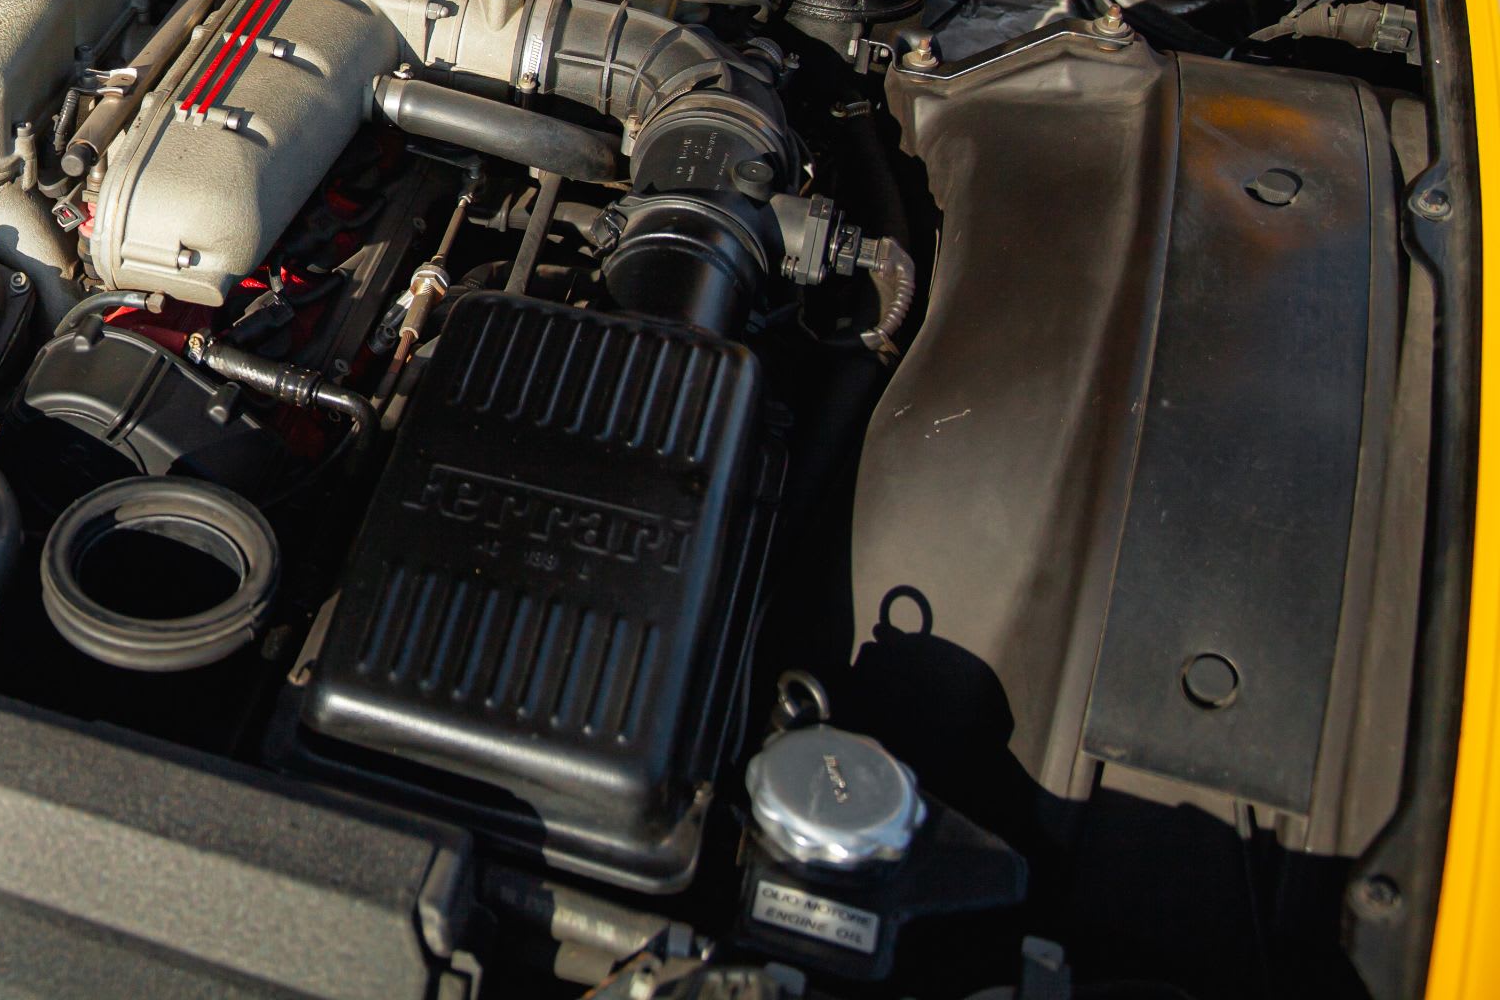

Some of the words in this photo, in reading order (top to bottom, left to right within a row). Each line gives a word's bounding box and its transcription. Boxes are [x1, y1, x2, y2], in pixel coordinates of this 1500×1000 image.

[762, 887, 799, 906] OLIO
[803, 899, 871, 928] MOTORE
[765, 906, 828, 932] ENGINE
[835, 927, 863, 944] OIL
